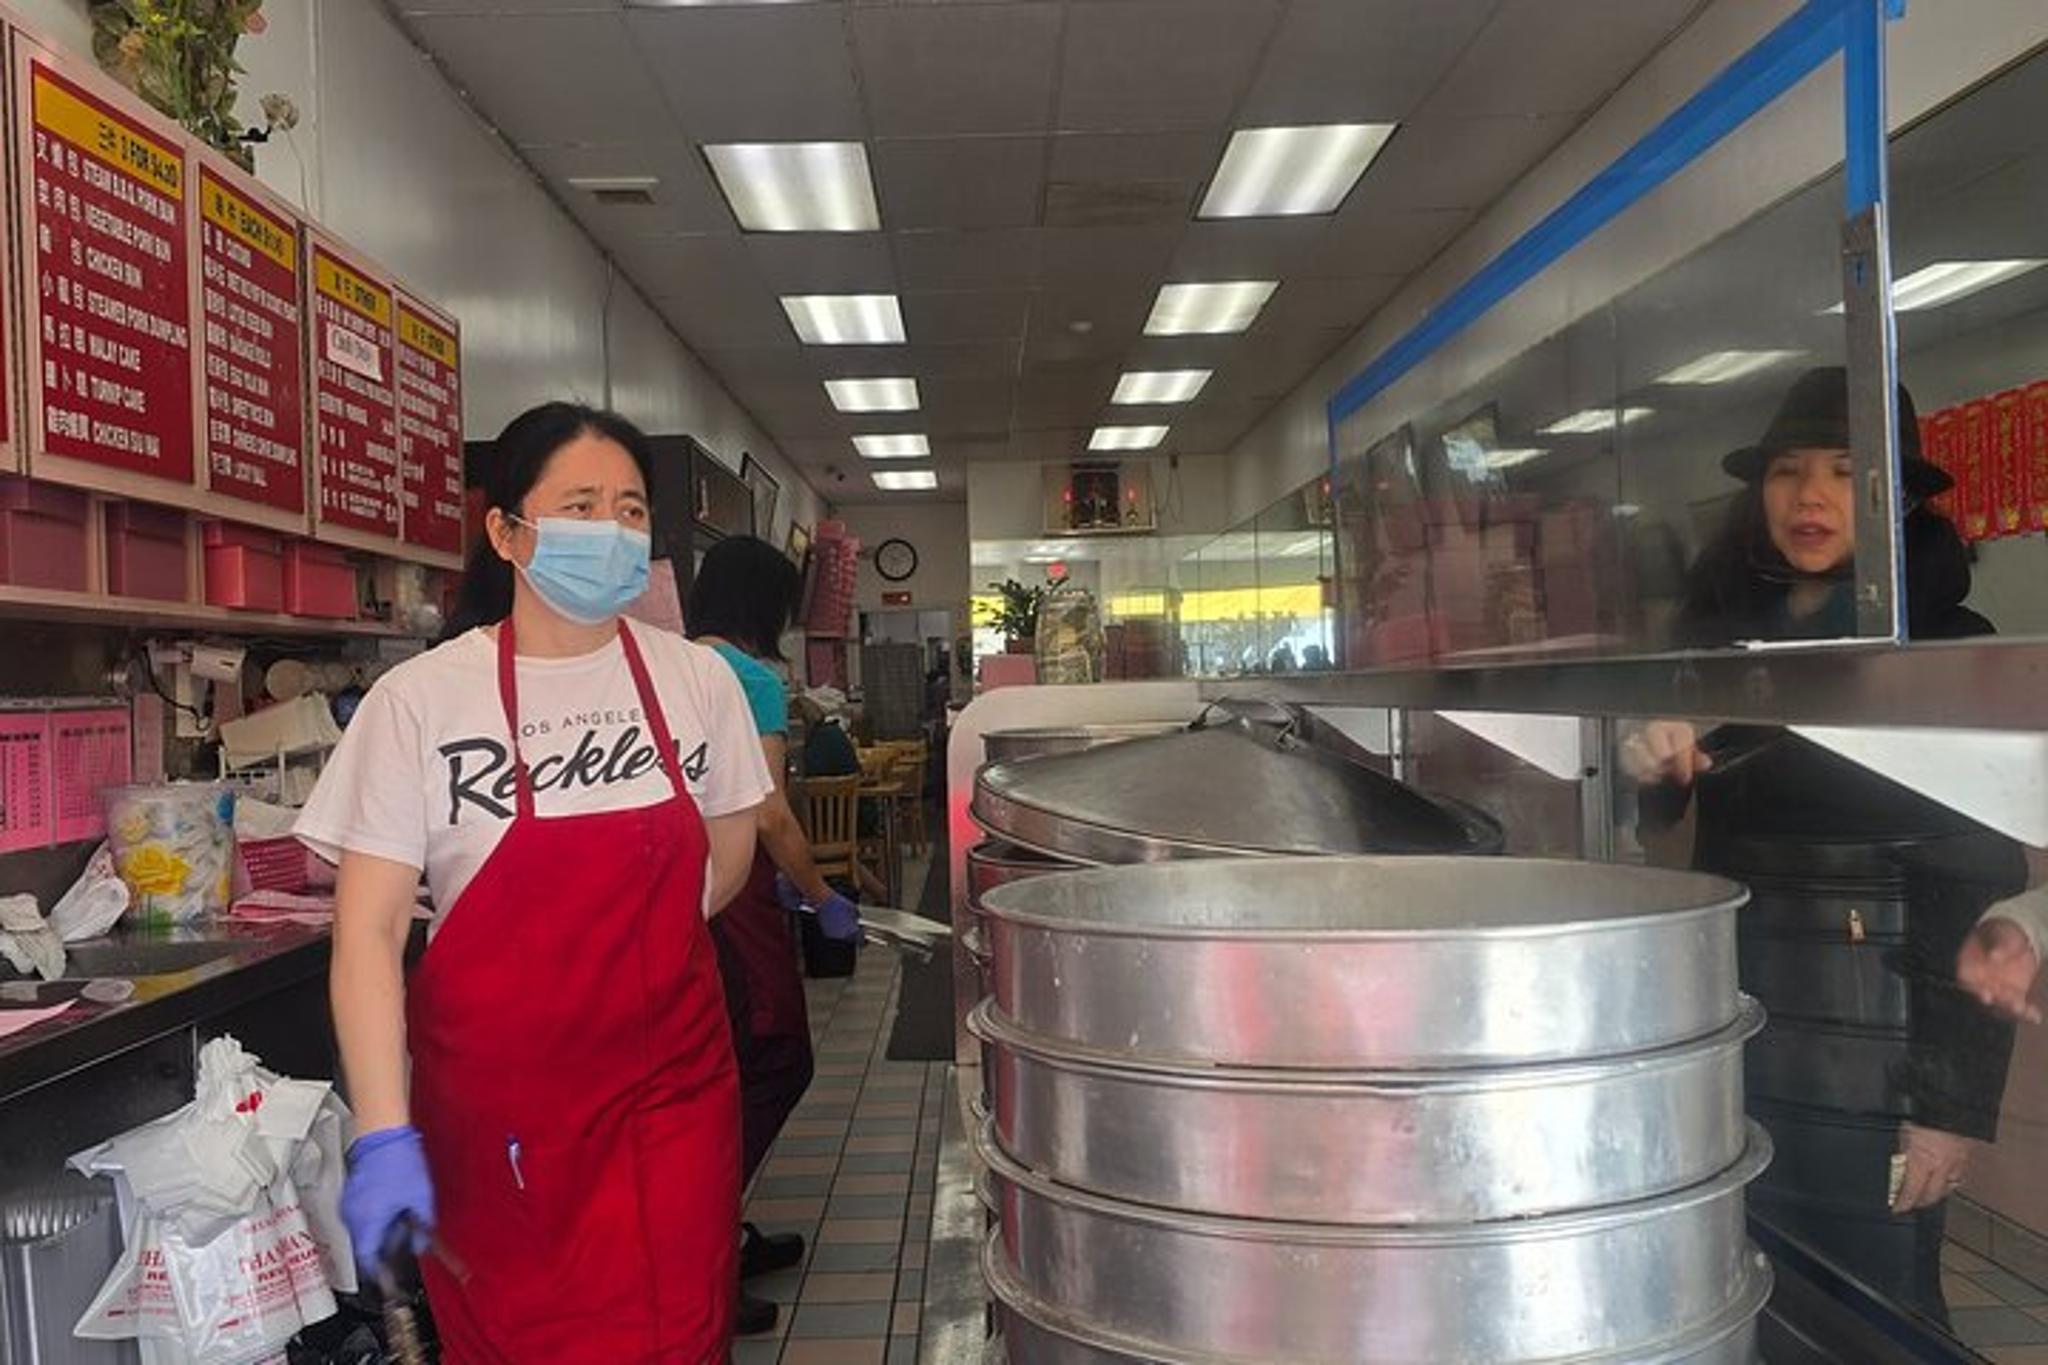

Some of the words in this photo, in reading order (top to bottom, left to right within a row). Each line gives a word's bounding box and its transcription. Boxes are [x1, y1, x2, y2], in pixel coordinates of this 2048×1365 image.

[86, 246, 122, 281] CHICKEN
[93, 419, 129, 449] CHICKEN
[562, 707, 648, 730] ANGELE
